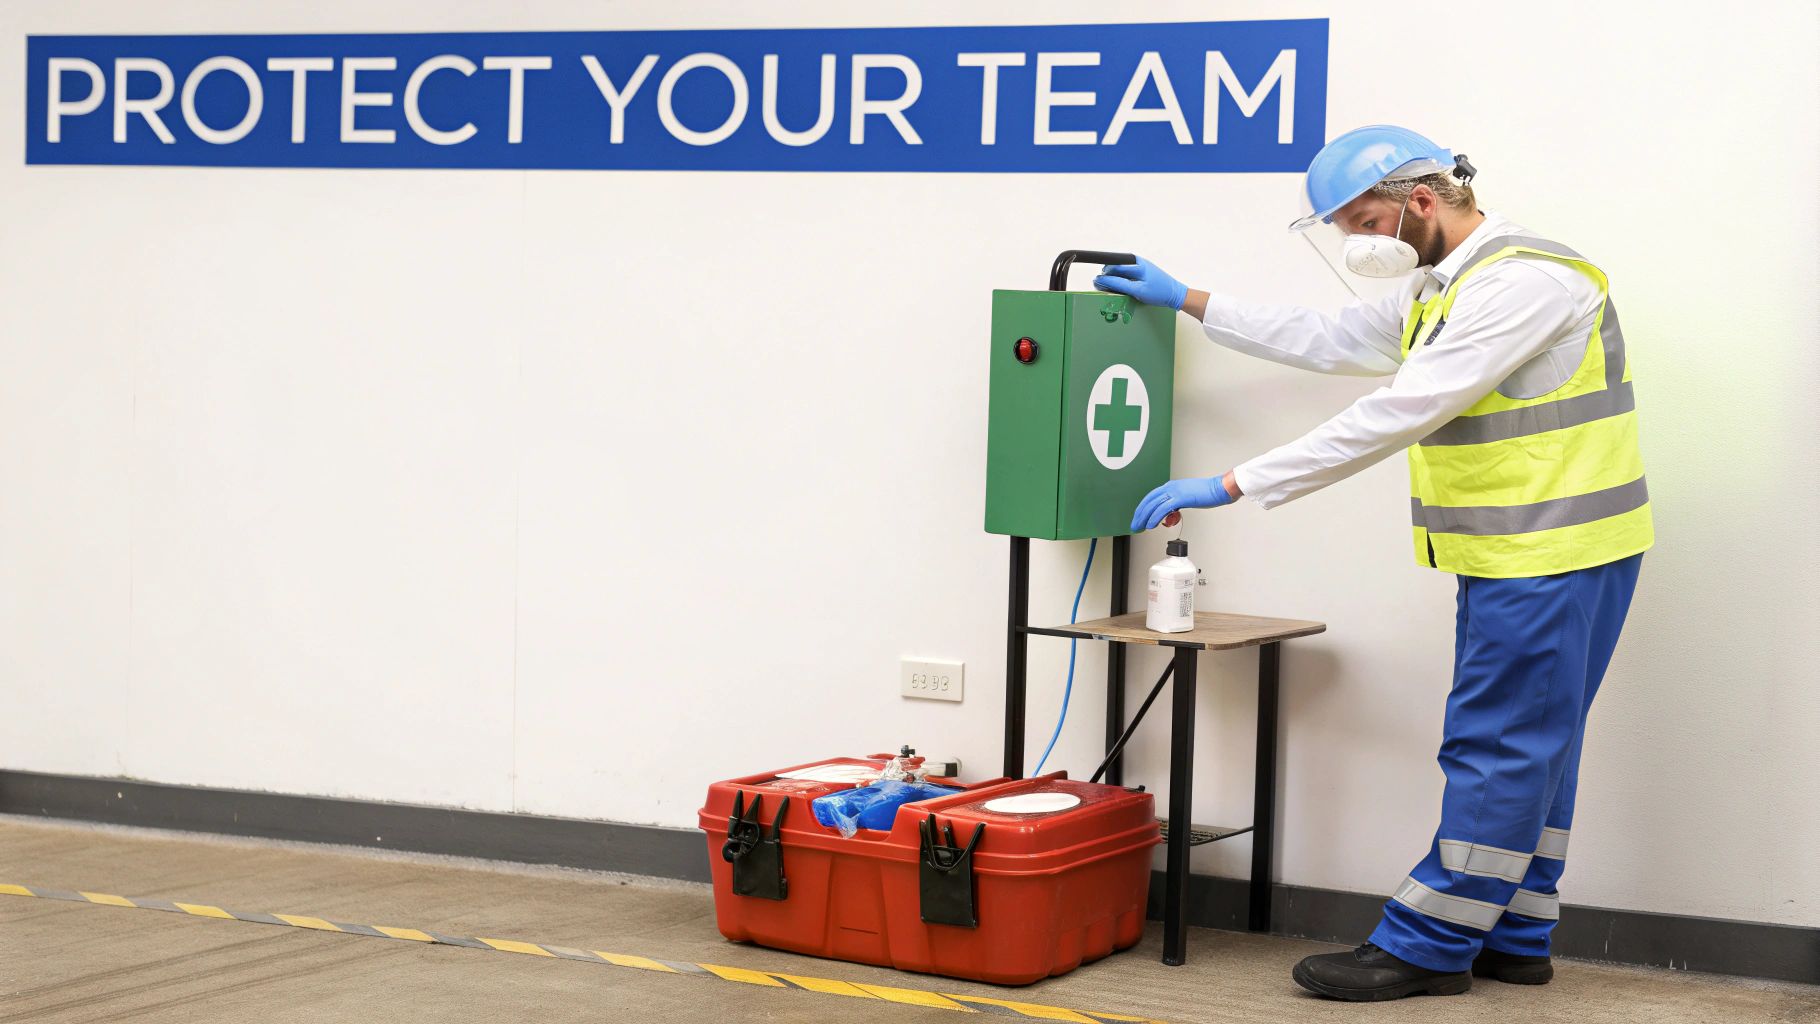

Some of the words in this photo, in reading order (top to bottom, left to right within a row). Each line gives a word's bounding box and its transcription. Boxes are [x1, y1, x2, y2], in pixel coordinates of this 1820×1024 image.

[47, 54, 553, 145] PROTECT
[581, 52, 923, 146] YOUR
[957, 49, 1297, 145] TEAM
